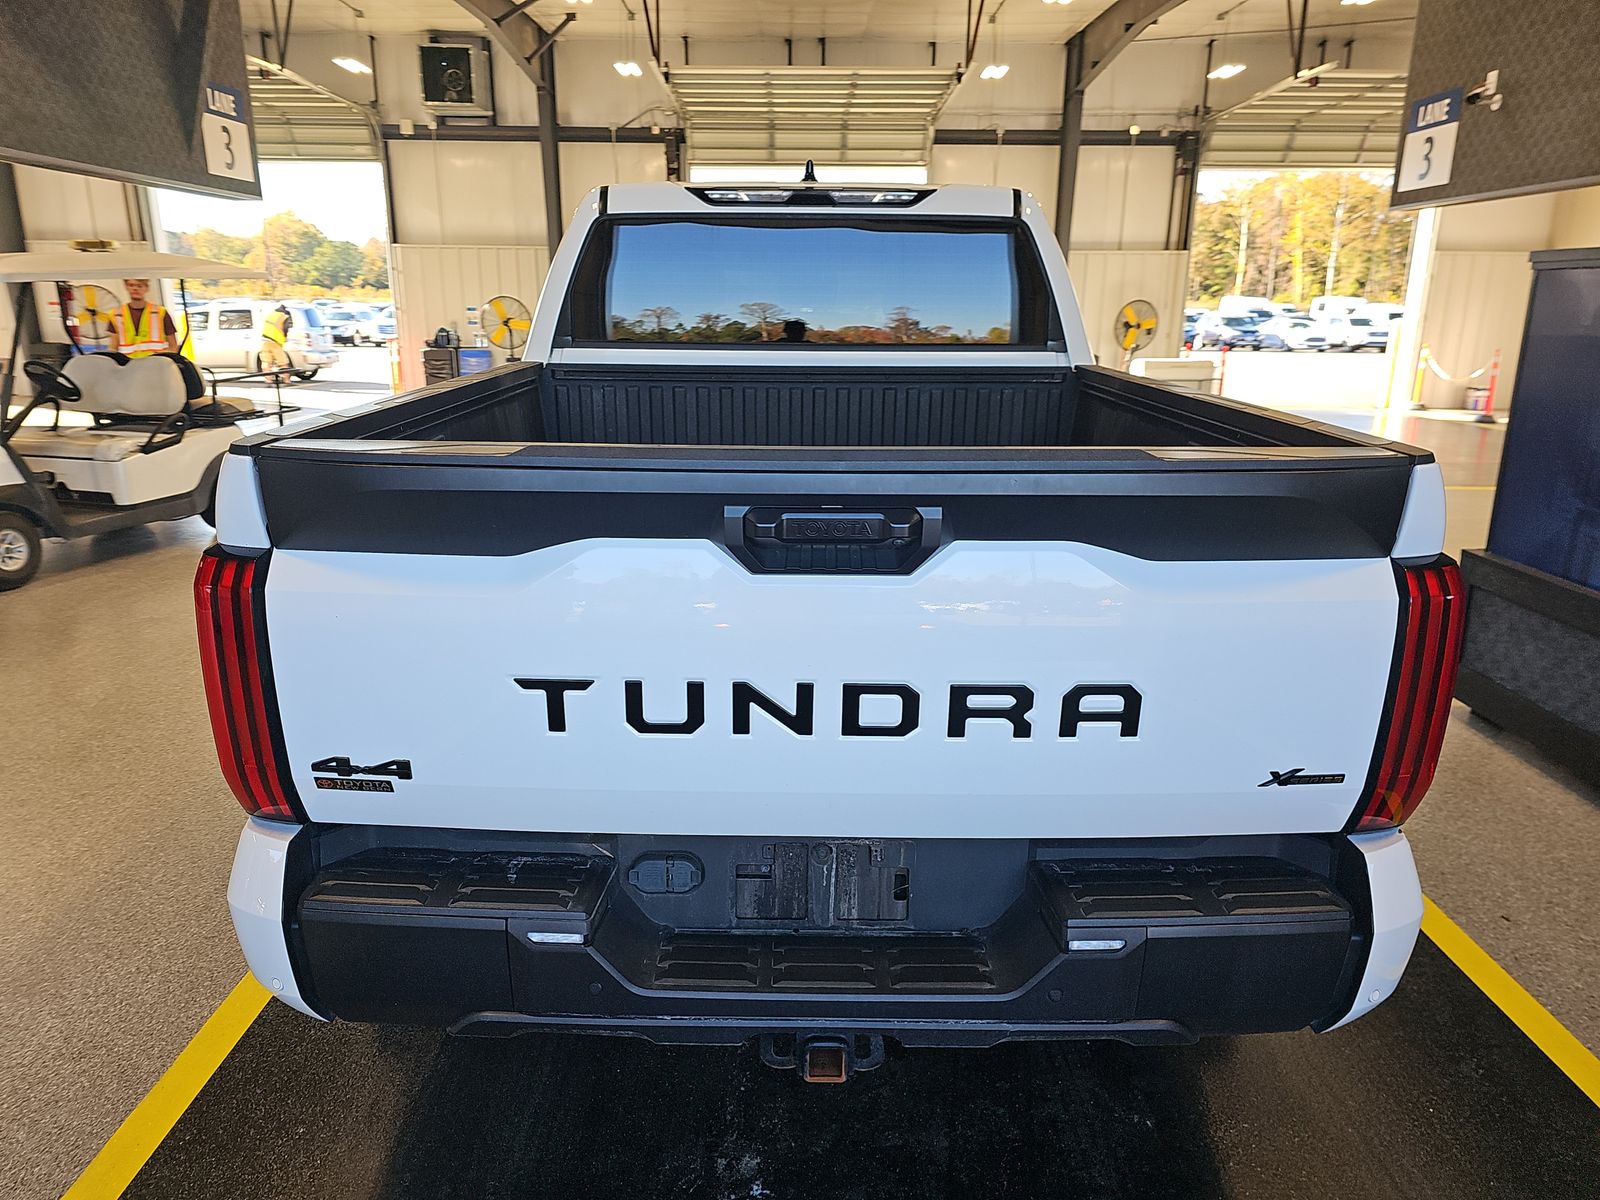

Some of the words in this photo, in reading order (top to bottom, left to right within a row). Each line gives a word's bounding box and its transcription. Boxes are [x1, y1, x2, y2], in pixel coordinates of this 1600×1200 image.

[206, 88, 237, 116] LANE
[1417, 98, 1451, 127] LANE
[221, 125, 234, 170] 3
[1418, 136, 1434, 180] 3
[792, 521, 873, 537] TOYOTA
[513, 678, 1143, 738] TUNDRA
[334, 779, 390, 788] TOYOTA
